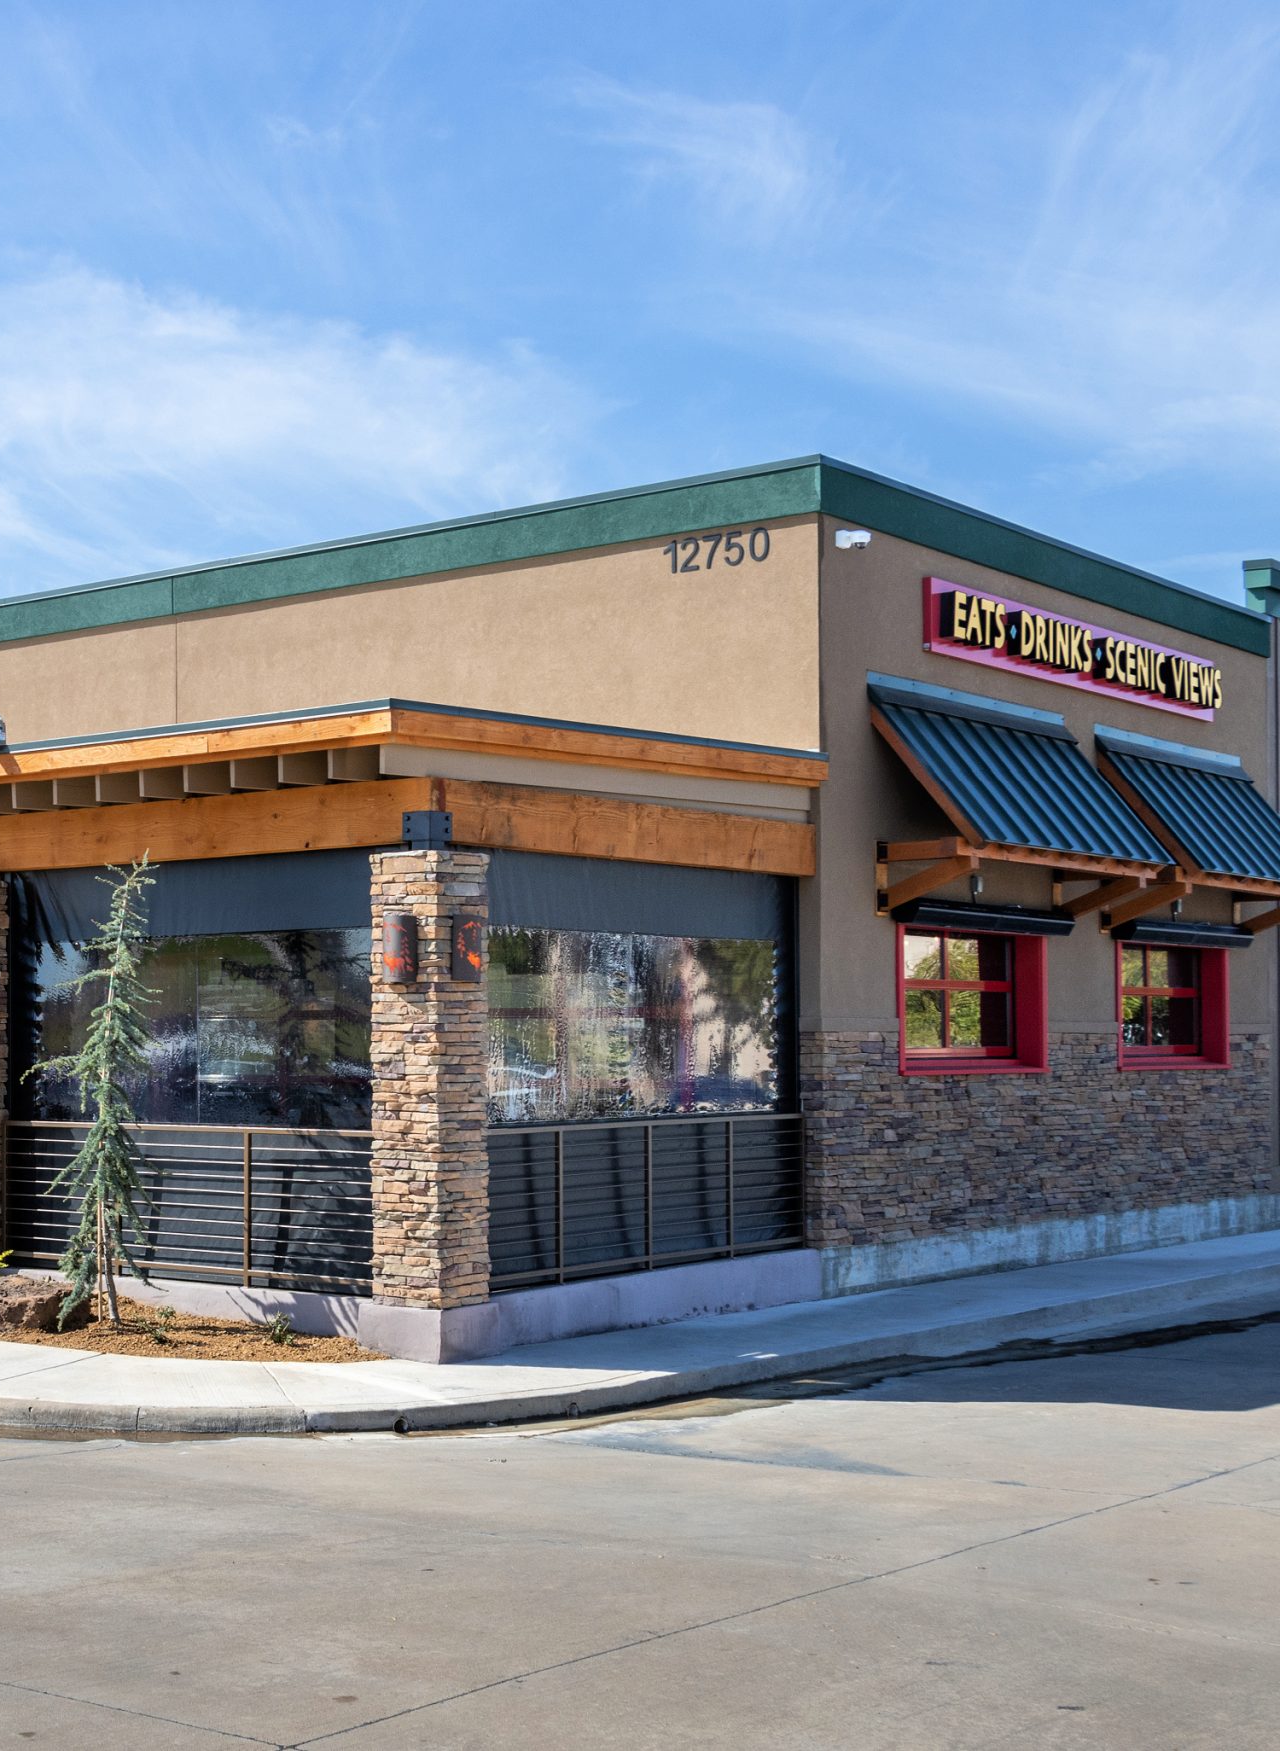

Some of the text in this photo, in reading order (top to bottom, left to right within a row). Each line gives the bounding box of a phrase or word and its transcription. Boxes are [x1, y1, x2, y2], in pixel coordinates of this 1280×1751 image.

[662, 527, 771, 574] 12750
[953, 590, 1223, 709] EATS DRINKS SCENIC VIEWS
